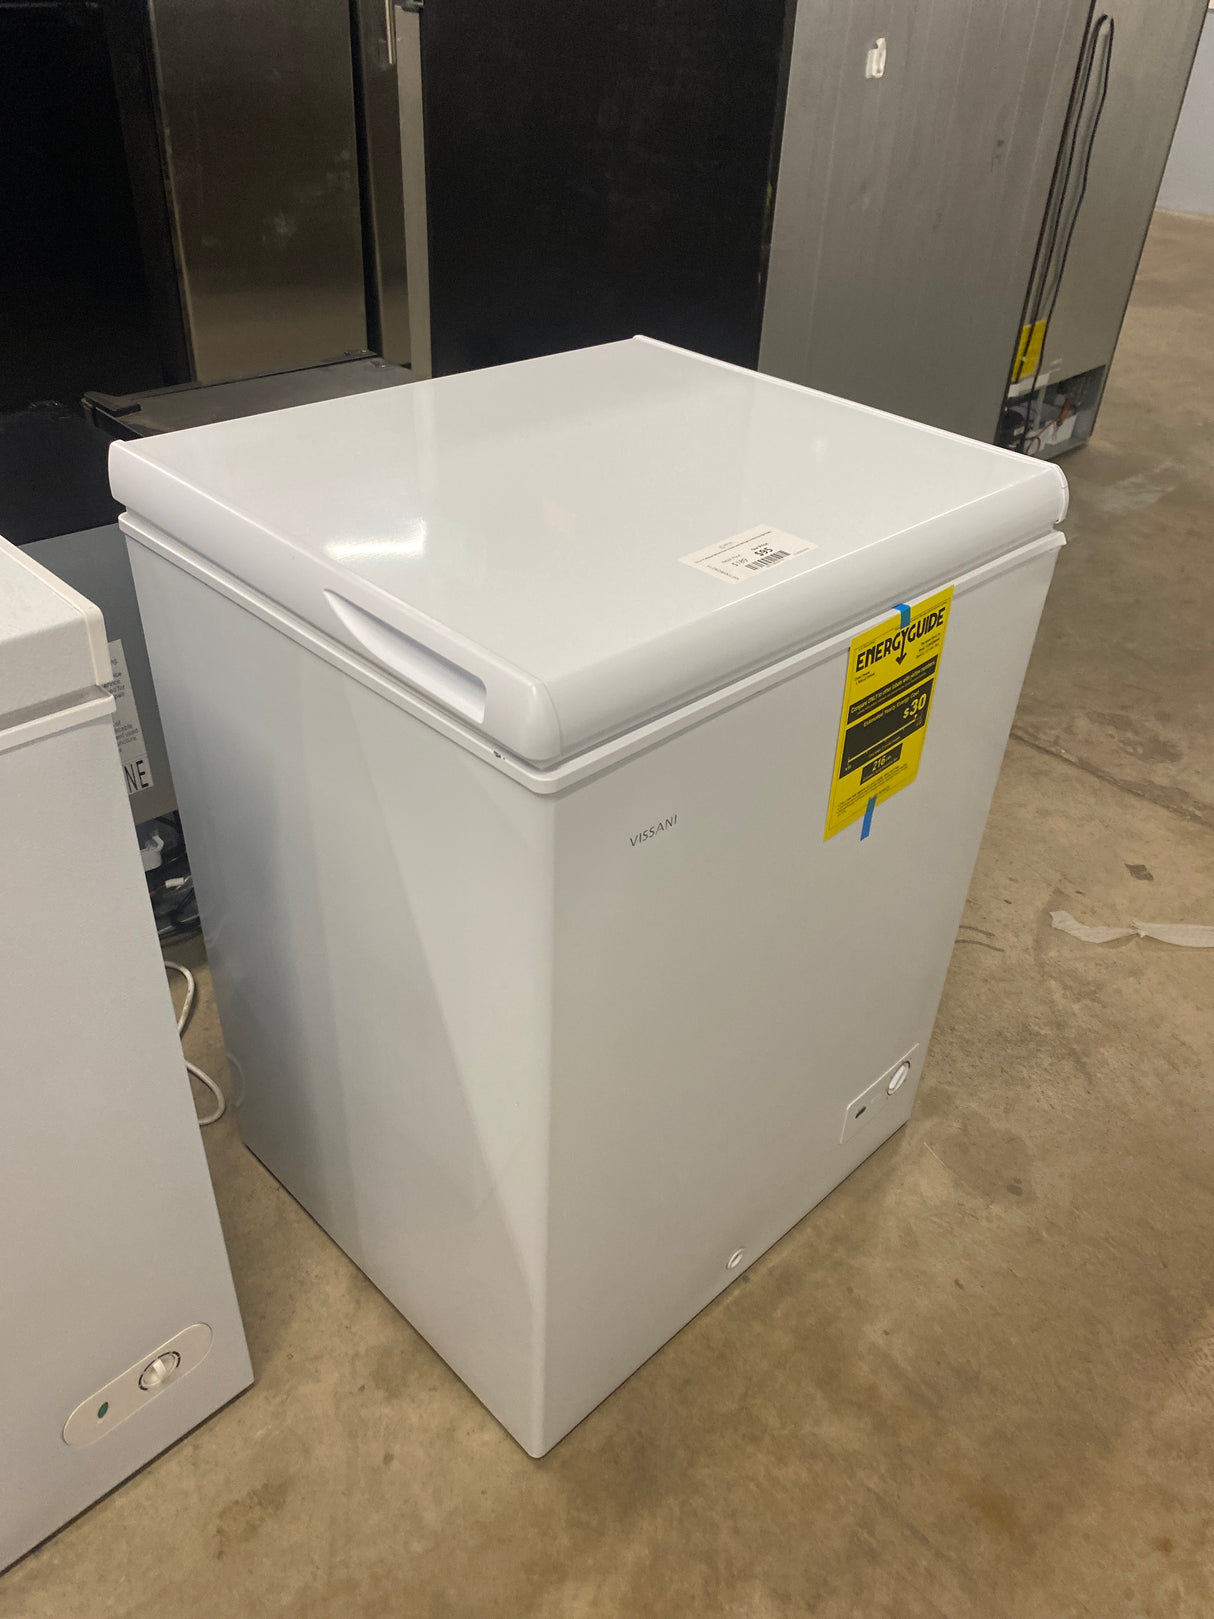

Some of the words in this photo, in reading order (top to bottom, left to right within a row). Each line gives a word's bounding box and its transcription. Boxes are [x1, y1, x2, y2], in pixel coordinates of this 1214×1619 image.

[754, 547, 773, 556] $95
[856, 607, 946, 673] ENERGYGUIDE
[903, 693, 927, 719] $30
[630, 814, 677, 847] VISSANI
